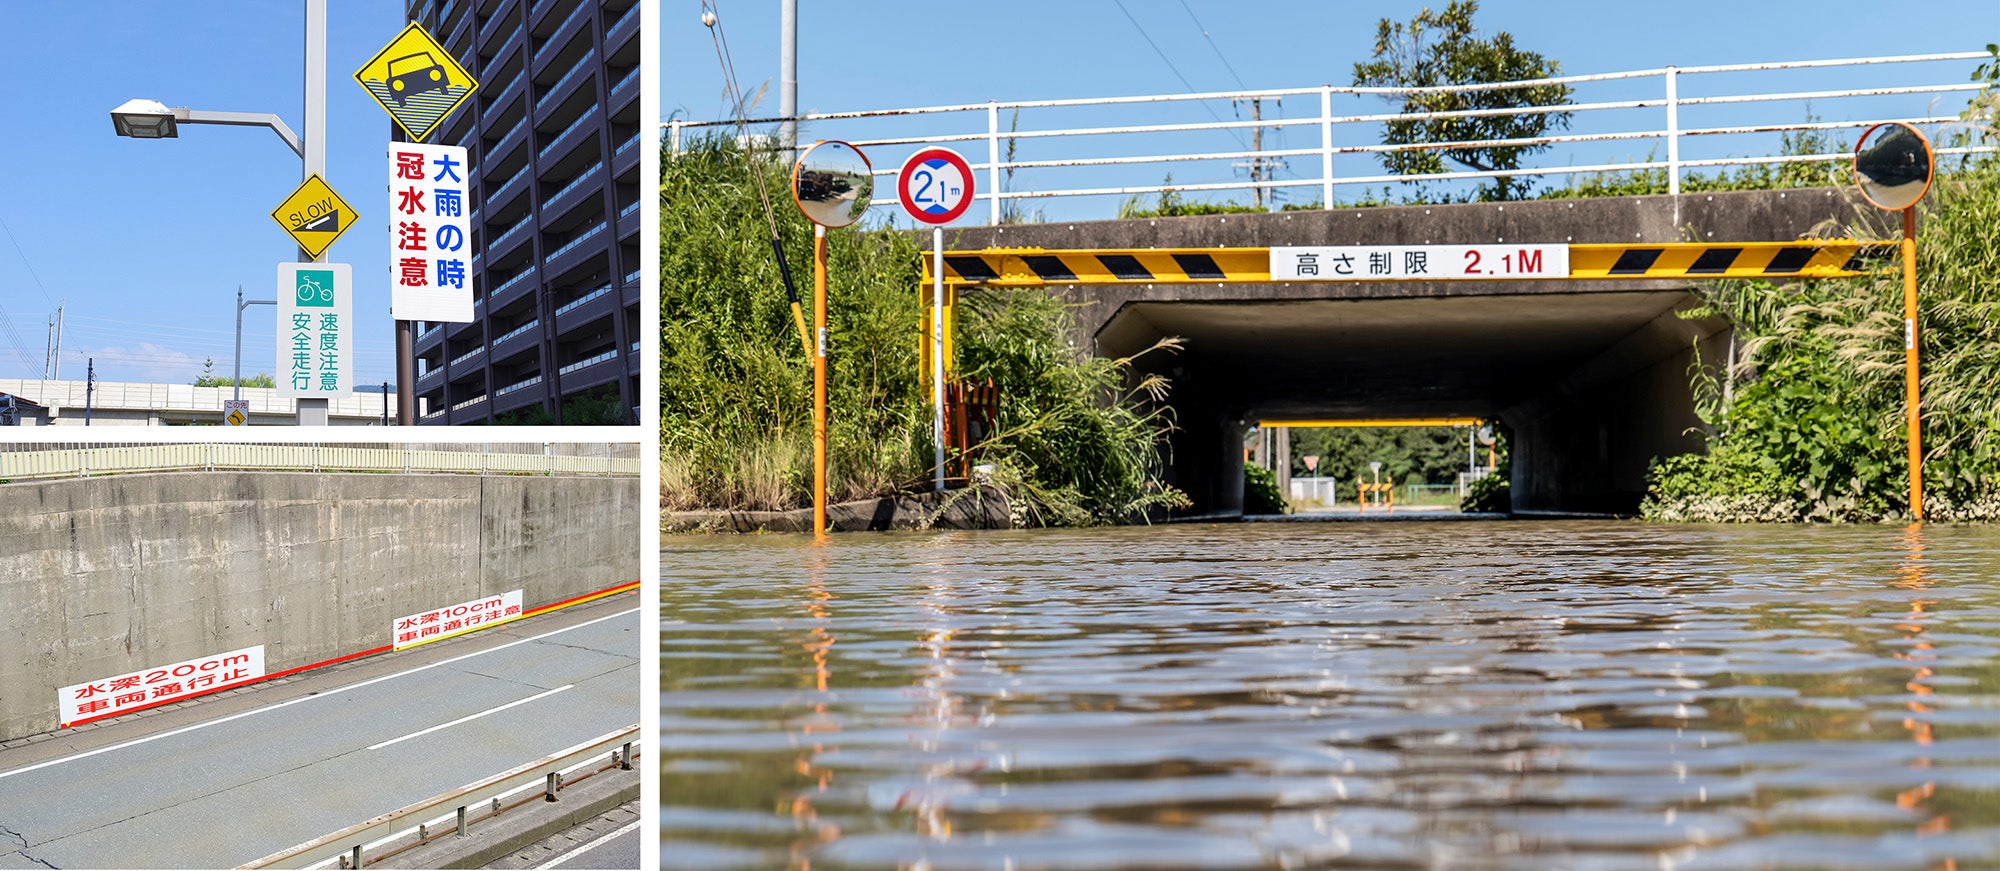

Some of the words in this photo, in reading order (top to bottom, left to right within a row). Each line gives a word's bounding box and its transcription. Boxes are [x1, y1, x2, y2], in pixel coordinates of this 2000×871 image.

[914, 170, 961, 203] 2.1m
[289, 197, 333, 227] SLOW
[397, 152, 428, 287] 冠水注意
[433, 154, 465, 289] 大雨の時
[1296, 251, 1428, 276] 高さ制限
[1464, 249, 1543, 275] 2.1M
[291, 312, 311, 390] 安全走行
[319, 312, 339, 391] 速度注意
[398, 598, 502, 630] 水深10cm
[398, 605, 521, 643] 車両通行注意
[75, 654, 249, 699] 水深20cm
[77, 668, 249, 715] 車両通行止
